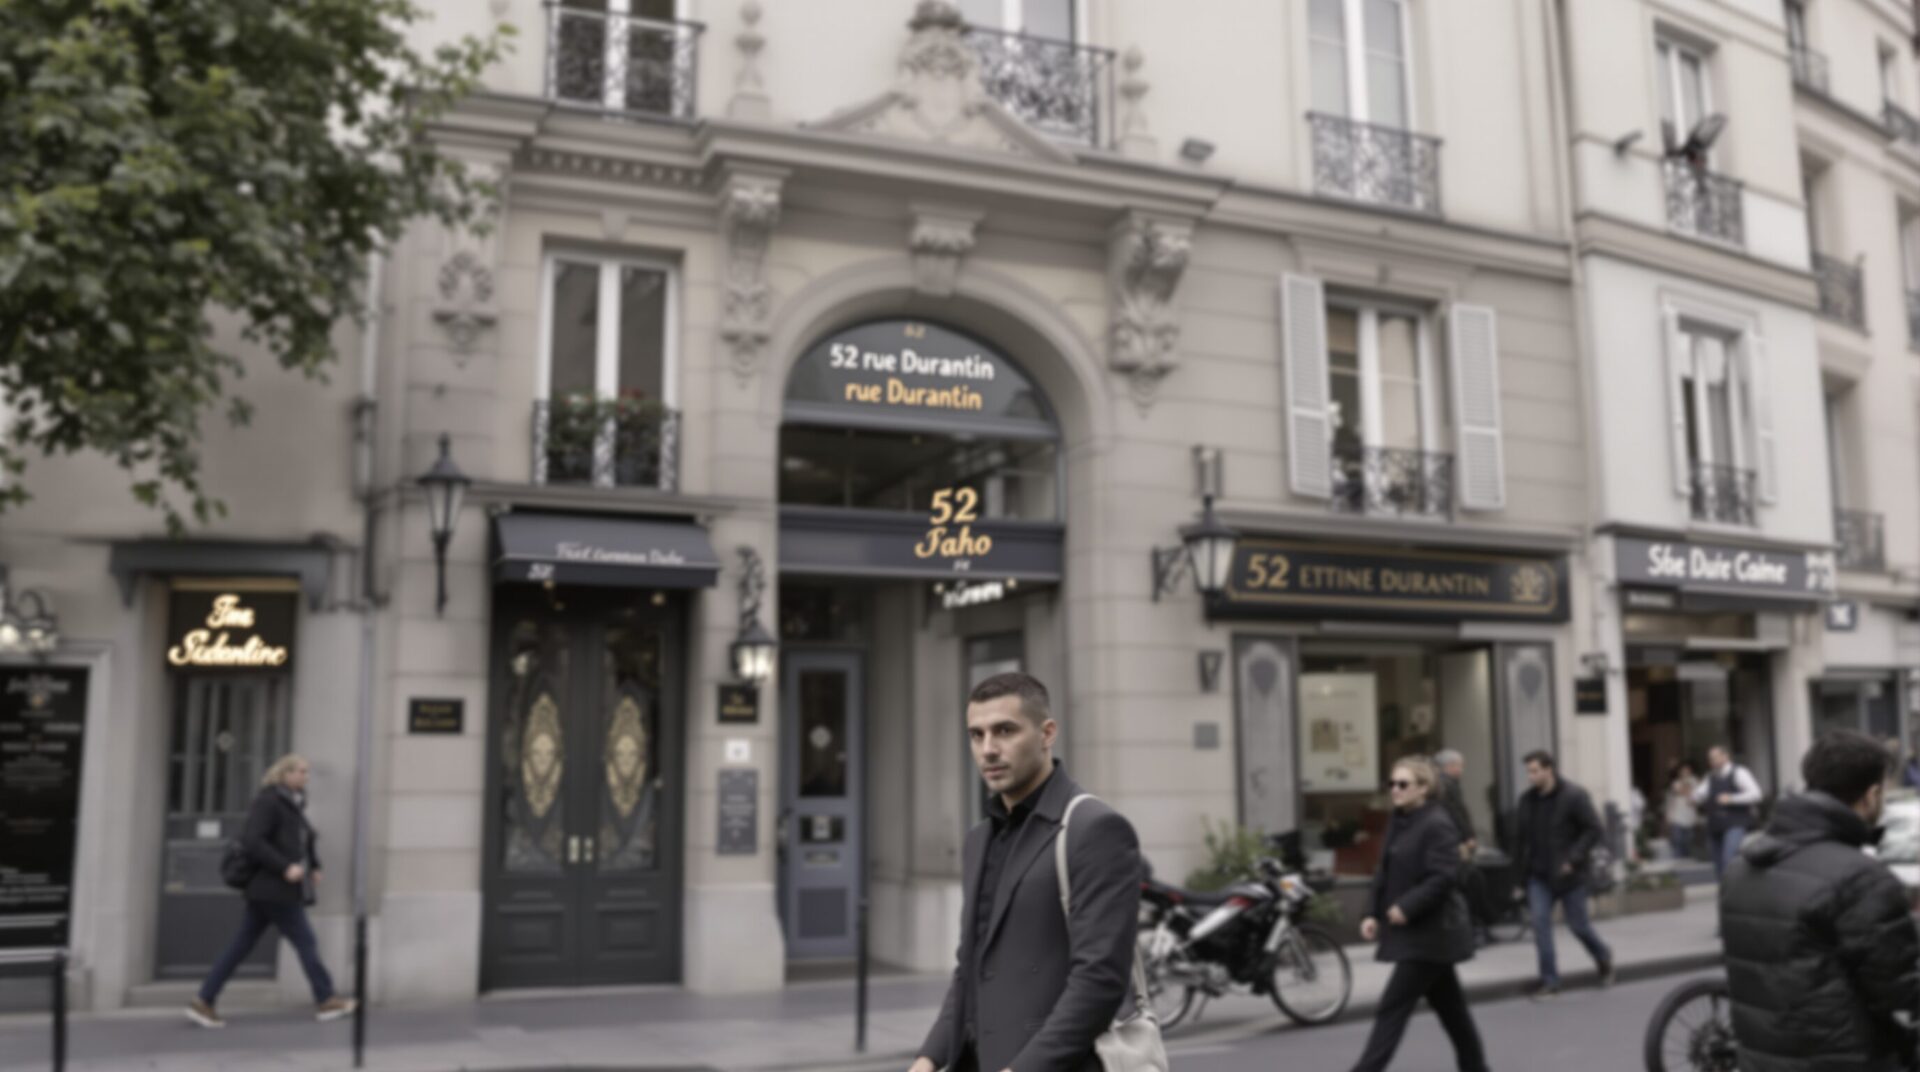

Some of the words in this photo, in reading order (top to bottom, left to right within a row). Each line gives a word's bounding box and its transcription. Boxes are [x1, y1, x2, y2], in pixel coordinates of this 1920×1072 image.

[829, 343, 859, 369] 52
[862, 351, 897, 373] rue
[901, 348, 995, 381] Durantin
[844, 381, 883, 402] rue
[886, 377, 982, 411] Durantin
[930, 486, 978, 525] 52
[1246, 553, 1290, 589] 52
[1300, 563, 1374, 592] ETTINE
[1379, 566, 1490, 597] DURANTIN
